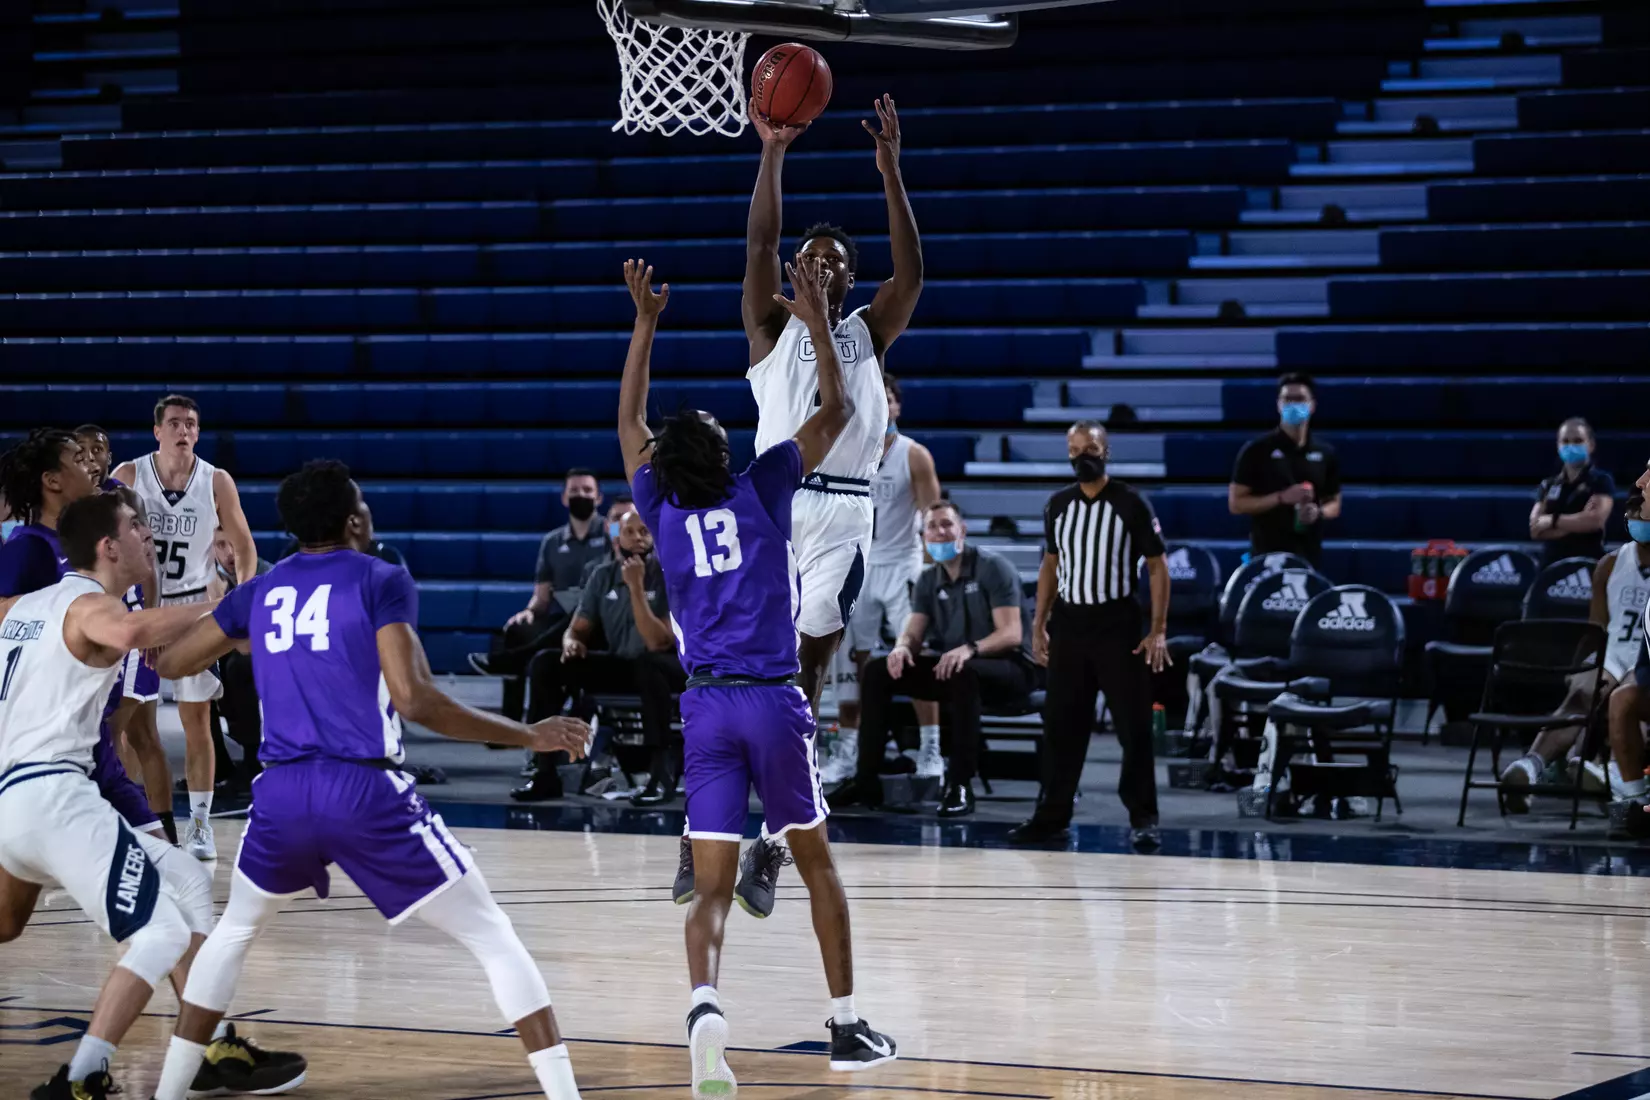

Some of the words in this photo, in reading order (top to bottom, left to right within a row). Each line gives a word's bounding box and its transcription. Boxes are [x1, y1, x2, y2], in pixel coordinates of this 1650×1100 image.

[755, 51, 787, 100] Wilson
[798, 335, 859, 364] CU
[148, 513, 198, 537] CBU
[685, 508, 743, 577] 13
[264, 583, 332, 654] 34
[1261, 598, 1308, 612] adida
[1317, 615, 1376, 631] adidas
[115, 843, 146, 915] LANCERS
